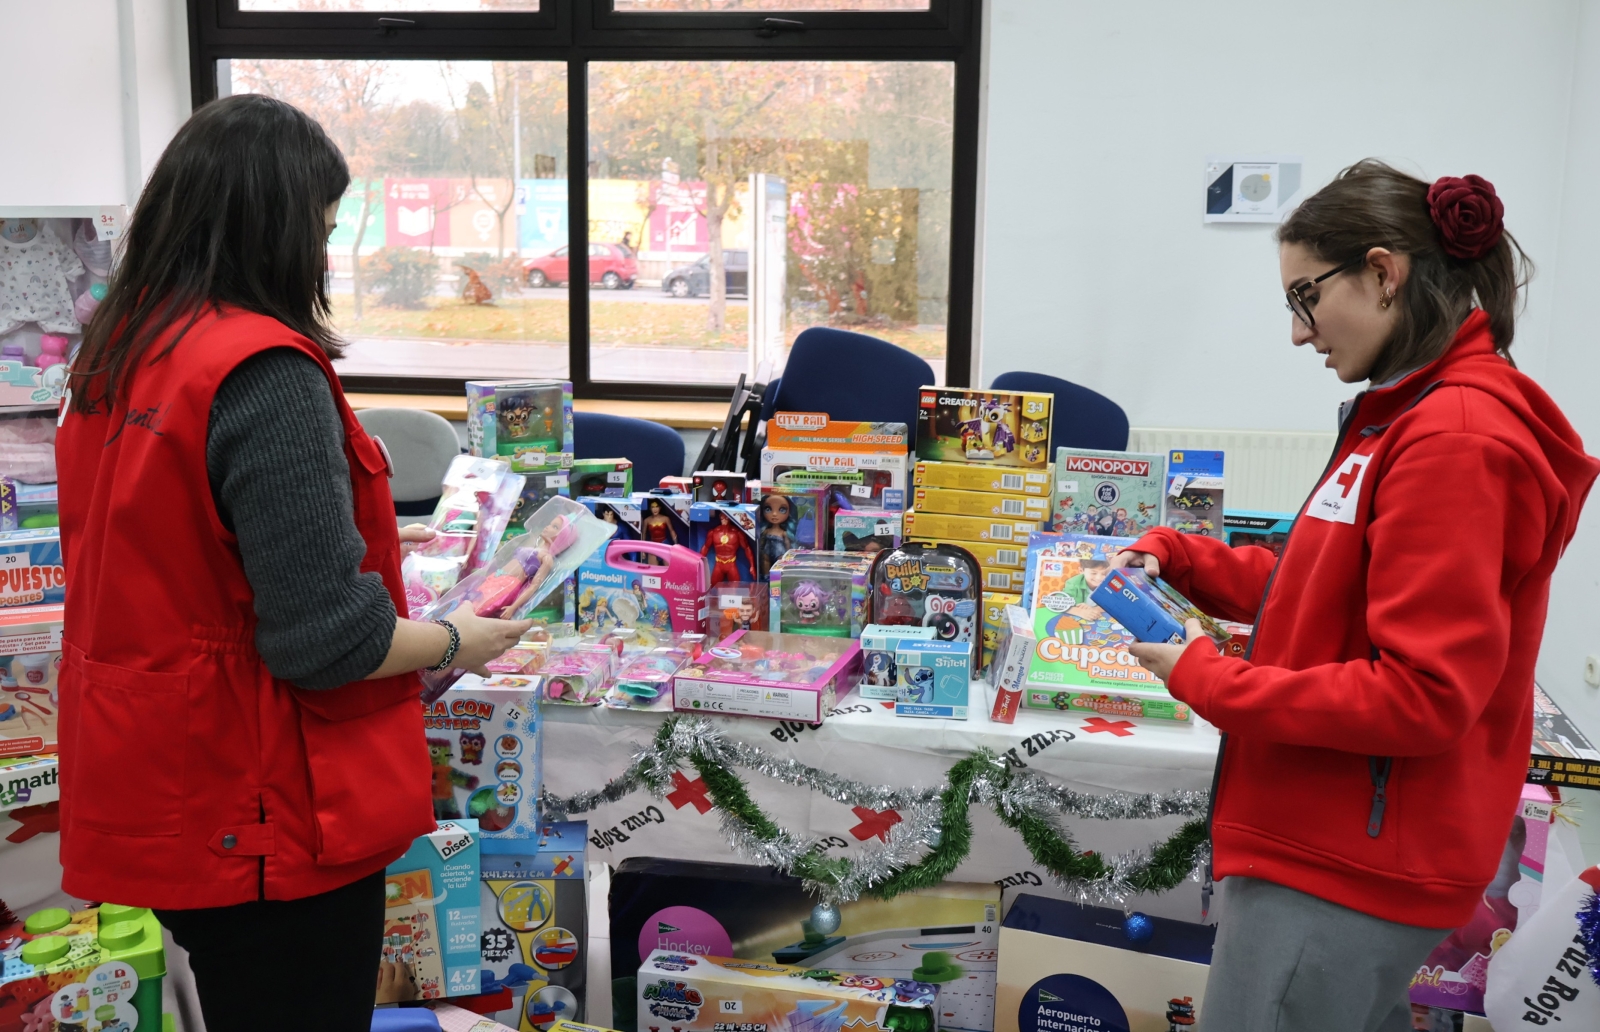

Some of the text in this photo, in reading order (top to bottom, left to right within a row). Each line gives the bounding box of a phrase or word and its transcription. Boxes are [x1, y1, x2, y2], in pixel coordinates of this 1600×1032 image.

[101, 214, 115, 223] 3+
[938, 397, 978, 407] CREATOR
[777, 415, 825, 426] CITY RAIL
[852, 434, 904, 444] HIGH-SPEED
[809, 456, 856, 466] CITY RAIL
[1068, 458, 1148, 475] MONOPOLY
[1174, 483, 1183, 491] 15
[6, 556, 16, 564] 20
[886, 560, 920, 578] Build
[581, 570, 623, 584] playmobil
[1122, 588, 1139, 602] CITY
[1040, 640, 1140, 669] Cupca
[935, 657, 966, 668] STITCH
[1012, 666, 1024, 690] Memos
[1030, 672, 1045, 680] 45
[1092, 665, 1128, 679] Pastel
[1131, 670, 1146, 680] en
[452, 700, 494, 720] CON
[1072, 698, 1142, 712] Cupcake
[506, 708, 520, 720] 15
[826, 704, 872, 718] Cru
[1021, 730, 1076, 758] Cruz
[1538, 760, 1551, 770] THE
[1553, 761, 1564, 770] OF
[1565, 762, 1586, 772] FOND
[1551, 772, 1566, 782] ARE
[589, 805, 665, 852] Cruz Roja
[441, 834, 471, 858] Diset
[813, 836, 848, 854] Cru
[443, 864, 471, 872] ¡Cuando
[529, 870, 545, 878] CM
[449, 911, 460, 920] 12
[982, 926, 992, 934] 40
[449, 933, 477, 944] +190
[485, 934, 508, 949] 35
[658, 937, 711, 955] Hockey
[482, 949, 513, 957] PIEZAS
[452, 982, 476, 992] años
[643, 983, 703, 1005] PJ MASKS
[724, 1002, 736, 1010] 20
[1522, 975, 1580, 1026] Roja
[1037, 1004, 1101, 1026] Aeropuerto
[1037, 1016, 1110, 1032] internacio
